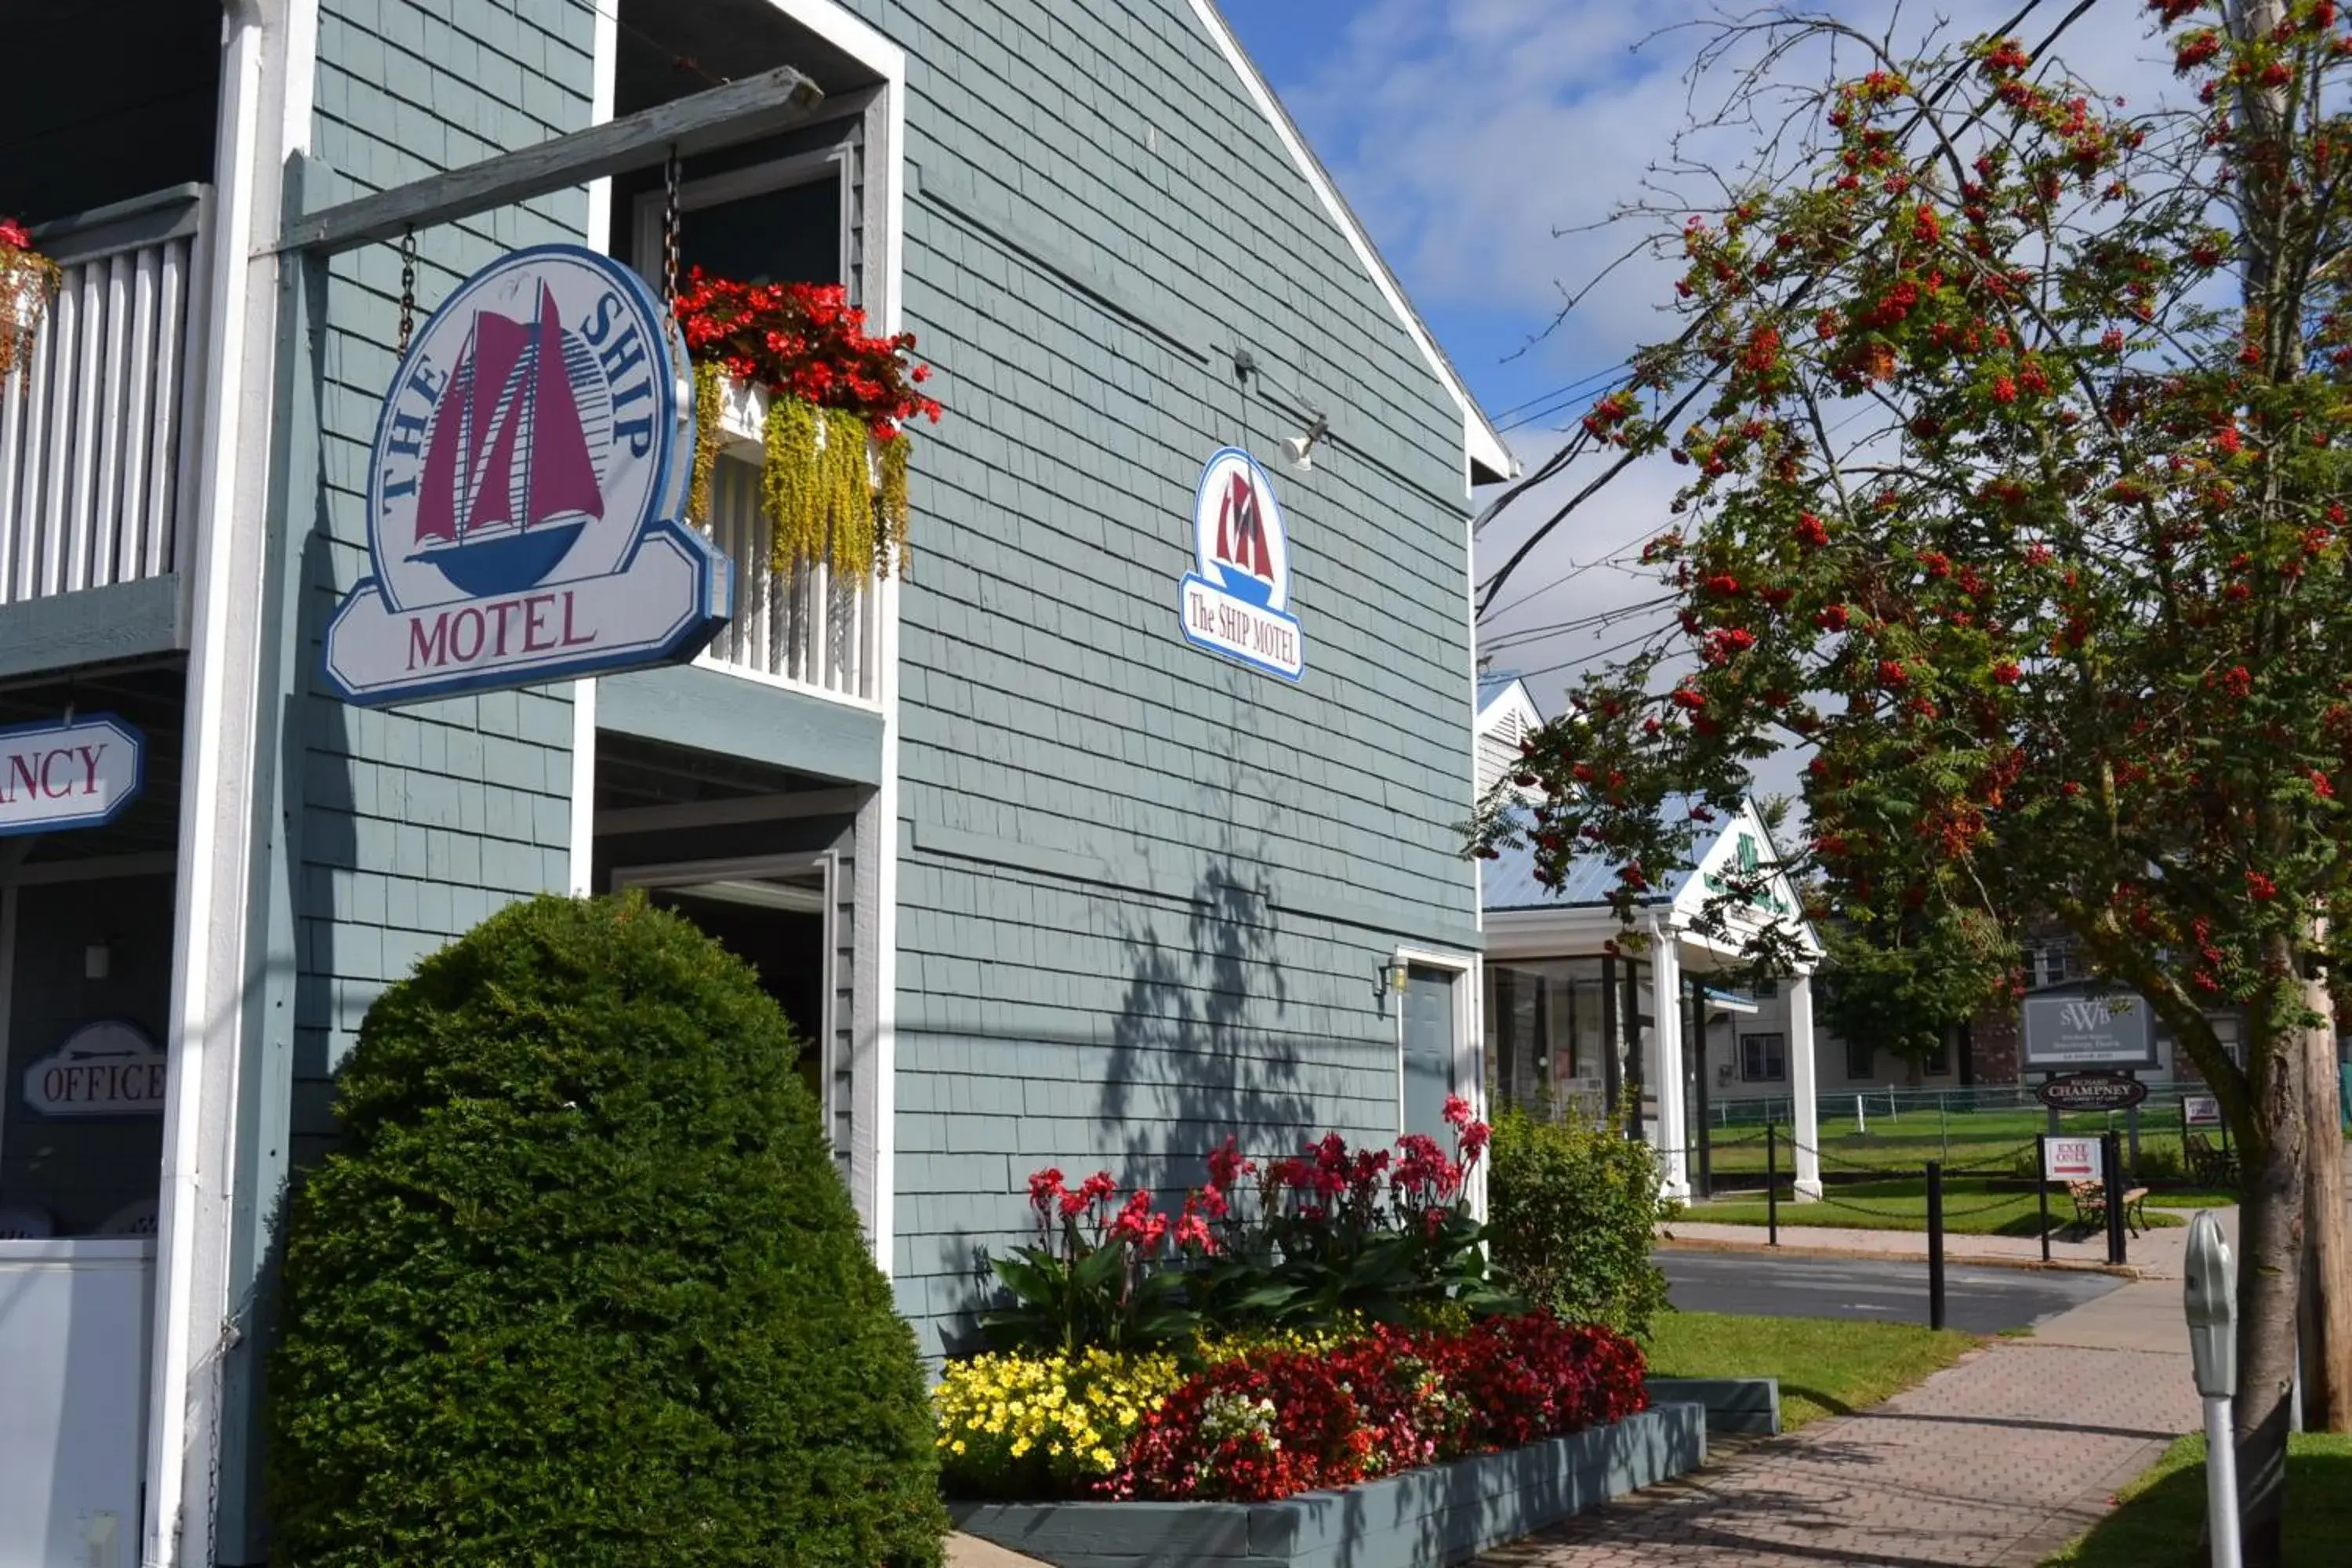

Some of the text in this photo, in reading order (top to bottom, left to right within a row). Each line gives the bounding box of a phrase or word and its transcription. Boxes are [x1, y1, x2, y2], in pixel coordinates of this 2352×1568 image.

[383, 291, 652, 515] THE SHIP
[405, 591, 597, 671] MOTEL
[1189, 590, 1296, 666] The SHIP MOTEL
[0, 743, 109, 804] NCY
[43, 1063, 166, 1103] OFFICE
[2048, 1084, 2132, 1098] CHAMPNEY
[2056, 1152, 2089, 1163] ONLY
[2057, 1143, 2089, 1153] EXIT
